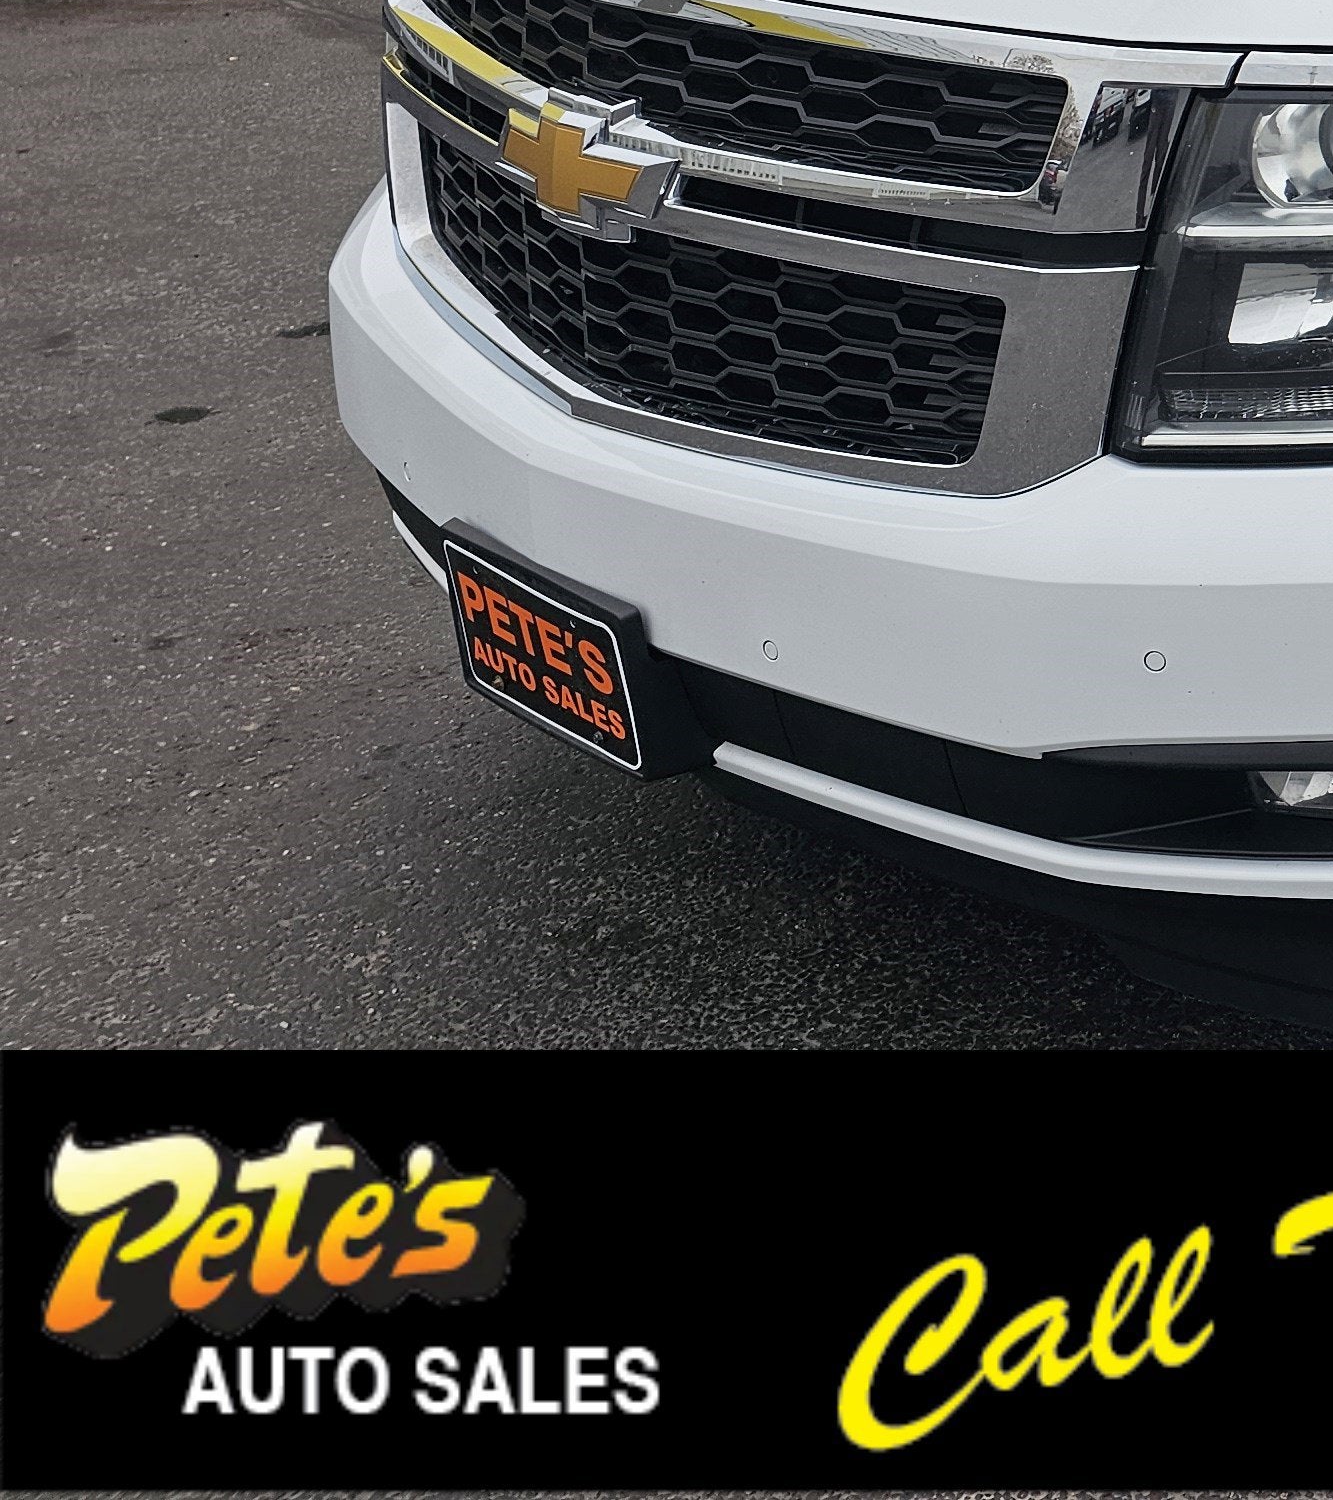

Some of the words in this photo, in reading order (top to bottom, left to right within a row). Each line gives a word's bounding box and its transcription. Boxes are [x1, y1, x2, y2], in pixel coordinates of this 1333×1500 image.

[457, 571, 614, 695] PETE'S
[474, 636, 537, 691] AUTO
[542, 675, 626, 740] SALES
